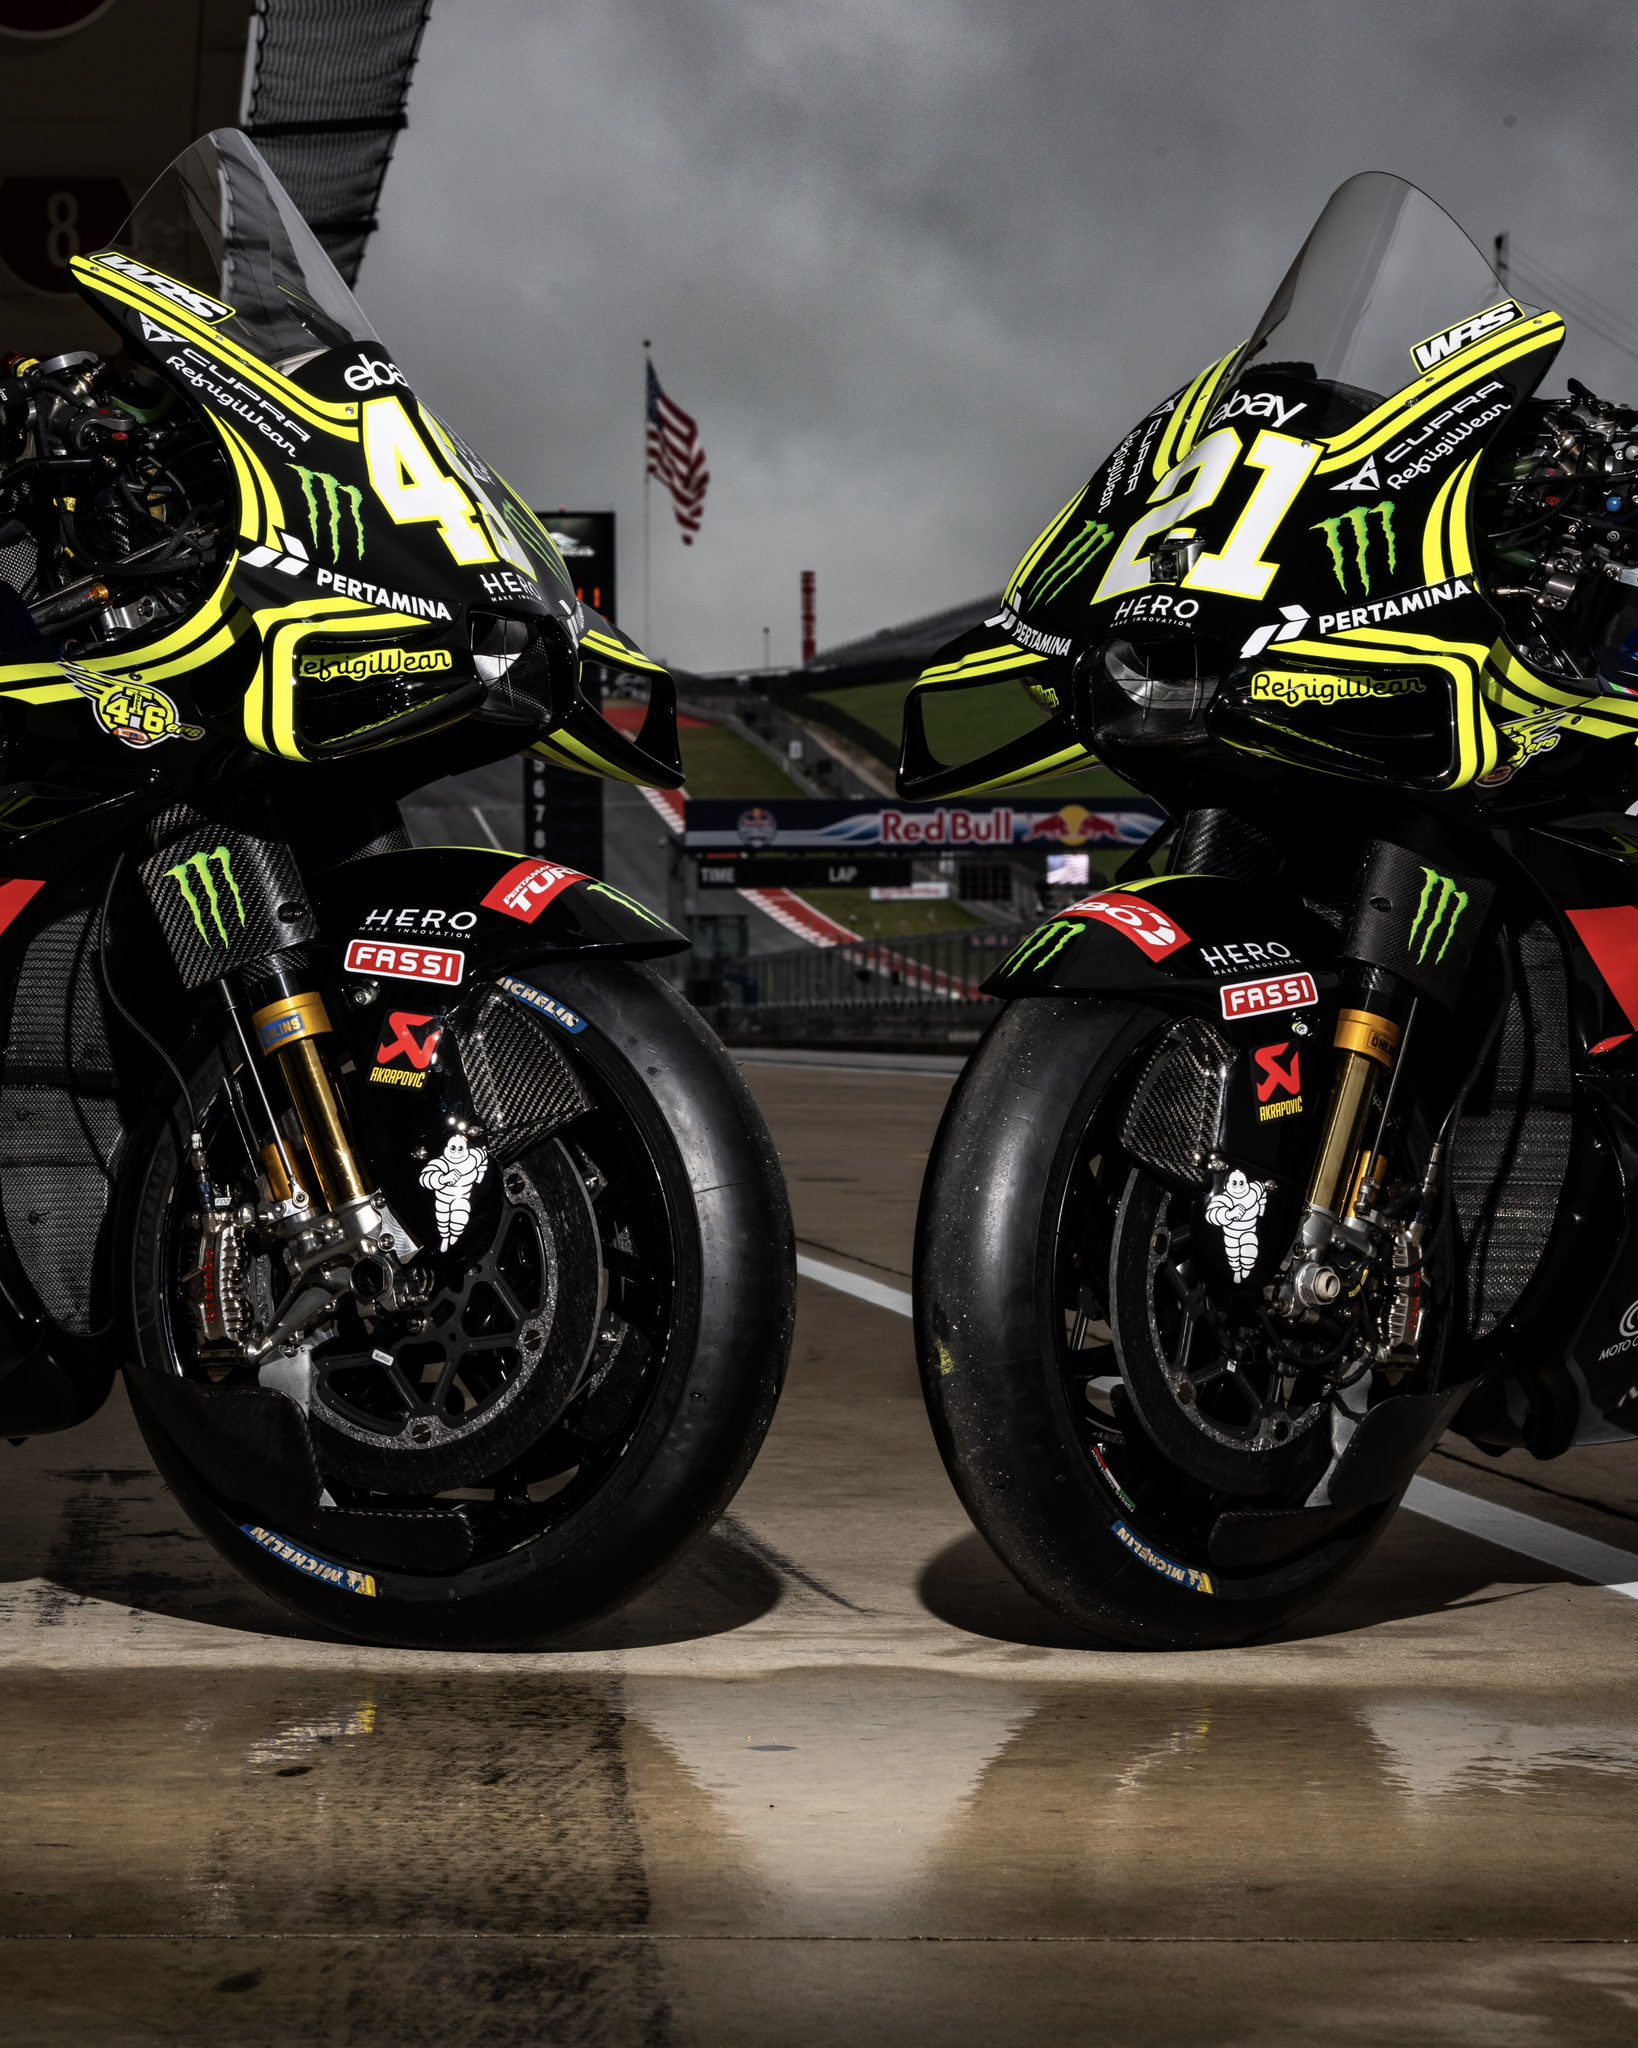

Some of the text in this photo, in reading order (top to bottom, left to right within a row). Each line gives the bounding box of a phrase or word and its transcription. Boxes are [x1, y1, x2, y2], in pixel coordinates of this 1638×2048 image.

[98, 255, 228, 318] WRS
[1415, 302, 1515, 369] WRS
[166, 356, 296, 458] RefrigiWear
[182, 348, 311, 443] CUPRA
[1208, 390, 1307, 429] ebay
[1384, 380, 1504, 464] CUPRA
[1123, 417, 1162, 496] CUPRA
[1387, 402, 1511, 490] RefrigiWear
[1090, 426, 1326, 605] 21
[317, 567, 452, 621] PERTAMINA
[480, 572, 542, 601] HERO
[1114, 595, 1199, 620] HERO
[1132, 616, 1191, 628] INNOVATION
[1319, 579, 1472, 635] PERTAMINA
[1011, 619, 1072, 657] PERTAMINA
[303, 650, 450, 681] efrigiWear
[533, 803, 546, 823] 7
[882, 808, 1013, 842] Red Bull
[503, 864, 551, 905] PERTAMAX
[508, 867, 577, 912] TUR
[700, 866, 735, 883] TIME
[828, 866, 859, 882] LAP
[359, 925, 471, 939] MAKE INNOVATION
[365, 908, 477, 931] HERO
[355, 947, 453, 978] FASSI
[1200, 941, 1292, 968] HERO
[1213, 957, 1301, 976] MAKE INNOVATION
[1230, 979, 1311, 1012] FASSI
[1599, 1339, 1631, 1361] MOTO
[250, 1526, 344, 1583] MICHELIN
[1117, 1527, 1186, 1582] MICHELIN
